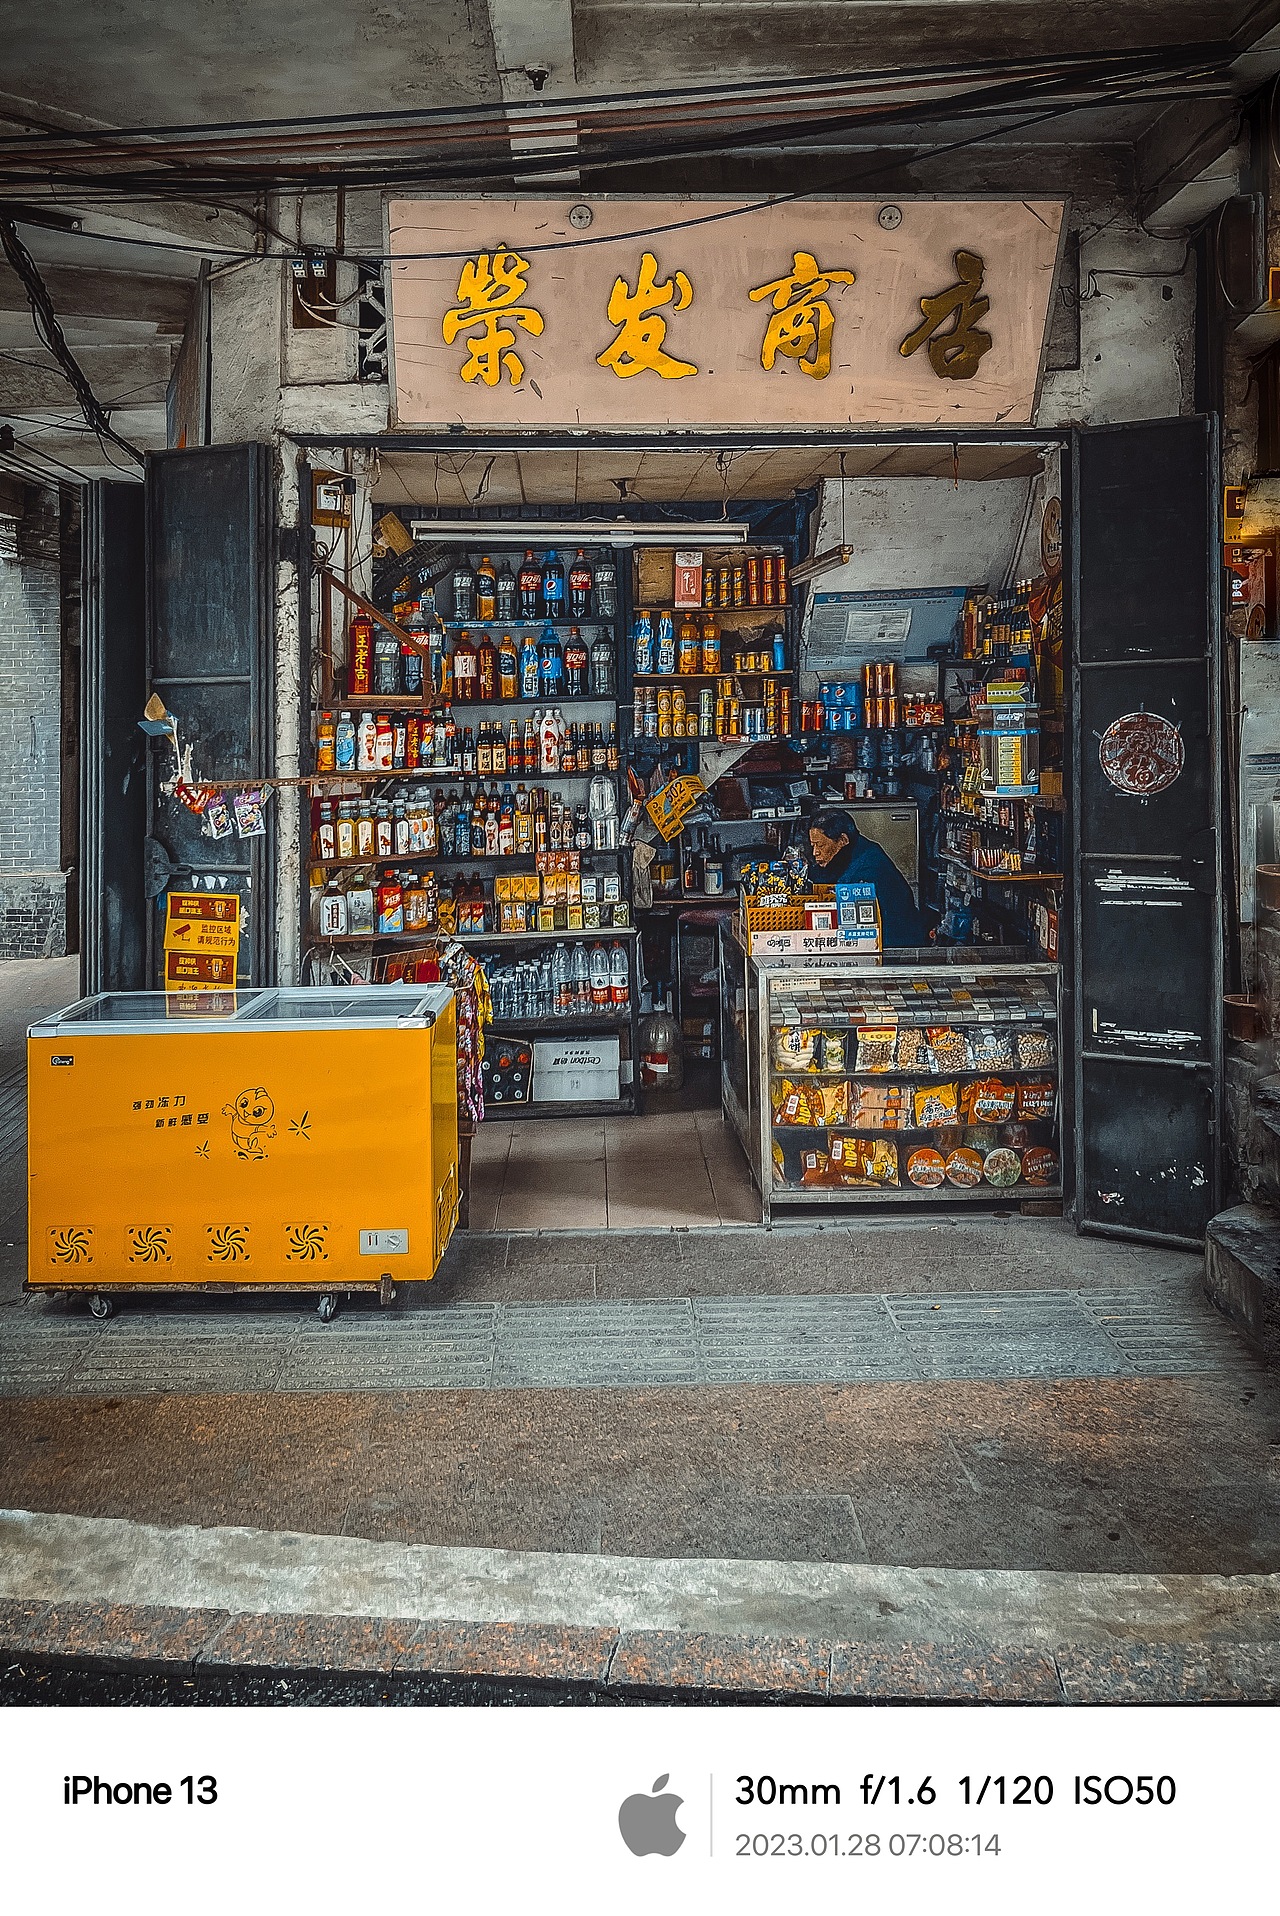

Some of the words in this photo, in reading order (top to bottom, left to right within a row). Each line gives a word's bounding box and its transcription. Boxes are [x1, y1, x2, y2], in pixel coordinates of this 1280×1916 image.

[355, 635, 368, 680] 王老吉
[665, 782, 686, 803] 502
[201, 924, 232, 935] 监控区域
[197, 936, 236, 947] 请规范行为
